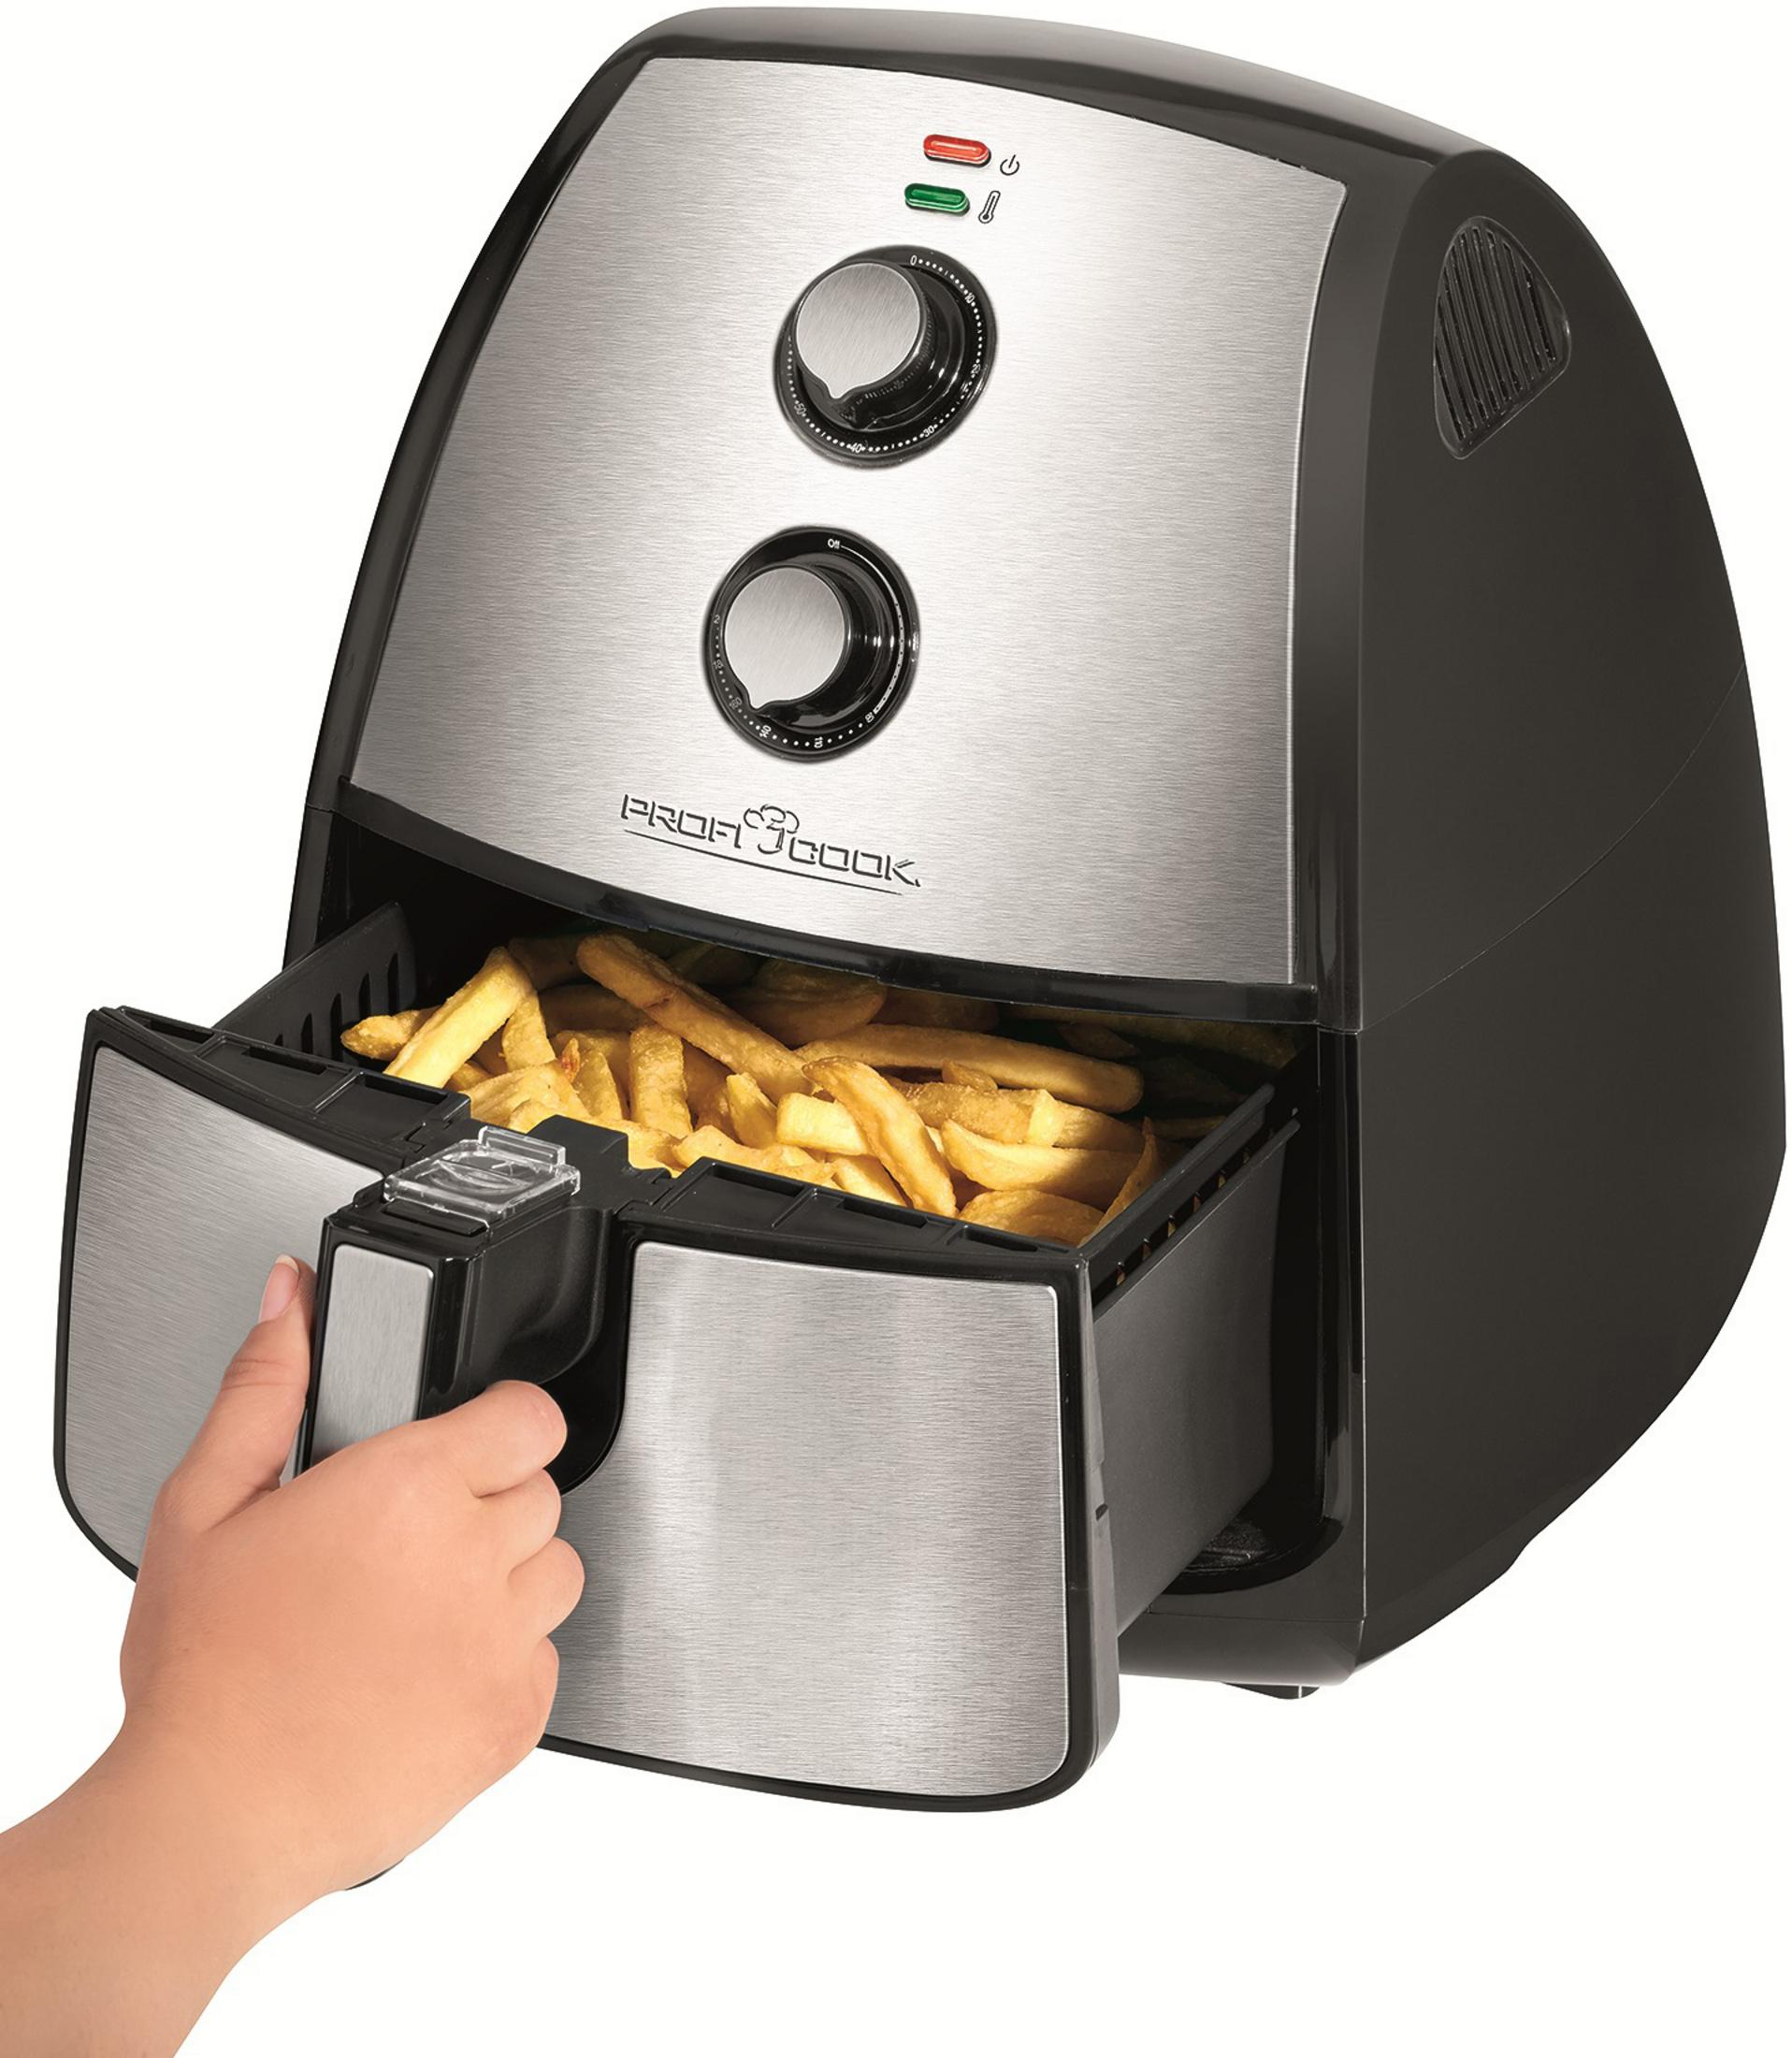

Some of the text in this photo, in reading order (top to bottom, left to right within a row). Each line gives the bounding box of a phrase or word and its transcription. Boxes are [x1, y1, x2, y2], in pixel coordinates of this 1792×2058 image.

[910, 254, 917, 266] 0
[964, 292, 975, 303] 10
[970, 363, 980, 374] 20
[795, 402, 804, 414] 50
[923, 425, 934, 438] 30
[850, 442, 861, 454] 40
[828, 538, 840, 549] Off
[864, 711, 874, 722] 80
[759, 724, 771, 738] 140
[620, 793, 742, 848] PROFI
